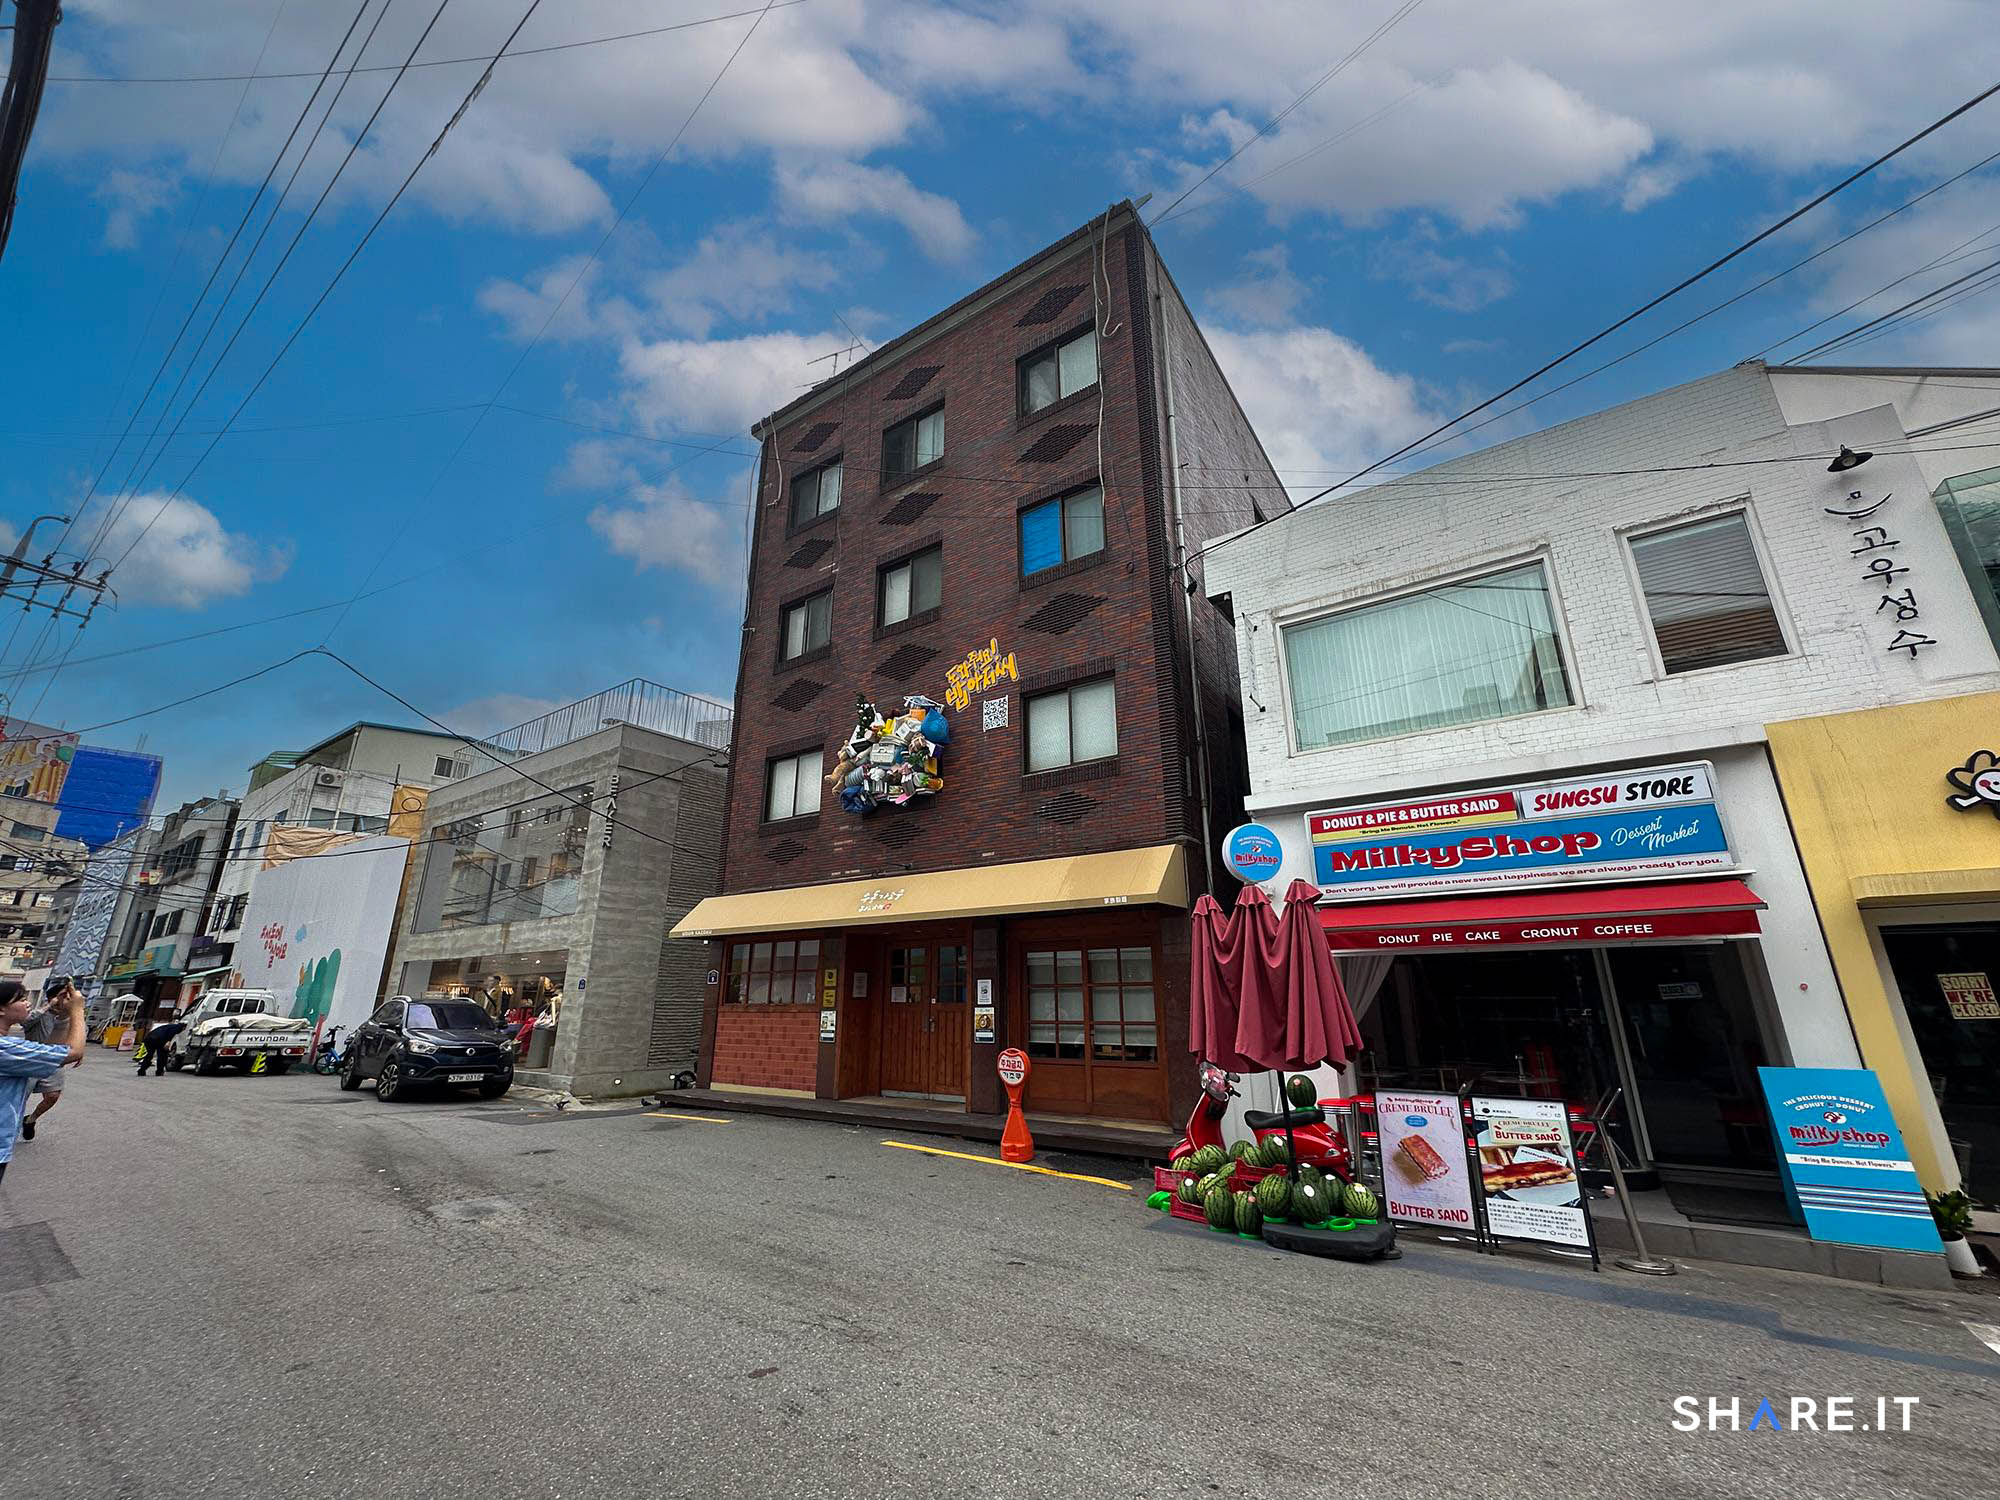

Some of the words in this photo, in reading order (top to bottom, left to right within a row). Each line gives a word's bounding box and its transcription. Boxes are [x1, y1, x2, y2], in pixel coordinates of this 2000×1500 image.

[1533, 784, 1618, 812] SUNGSU
[1625, 775, 1695, 801] STORE
[1322, 815, 1363, 831] DONUT
[1365, 814, 1376, 825] &
[1376, 811, 1397, 824] PIE
[1398, 810, 1409, 821] &
[1410, 803, 1460, 820] BUTTER
[1462, 799, 1500, 814] SAND
[1610, 815, 1663, 846] Dessert
[1641, 819, 1700, 850] Market
[1330, 831, 1602, 872] MilkyShop
[1325, 886, 1348, 894] Don't
[1407, 880, 1444, 889] provide
[1503, 871, 1558, 880] happiness
[1597, 864, 1638, 873] always
[1639, 861, 1675, 869] ready
[1676, 859, 1695, 867] for
[1695, 857, 1723, 866] you.
[1378, 934, 1421, 944] DONUT
[1432, 932, 1453, 942] PIE
[1465, 930, 1501, 941] CAKE
[1520, 926, 1580, 939] CRONUT
[1593, 923, 1654, 936] COFFEE
[1940, 976, 1989, 990] SORRY
[1951, 1003, 2000, 1017] CLOSED
[1001, 1059, 1022, 1069] 주차금지
[1783, 1098, 1797, 1107] THE
[1796, 1094, 1837, 1102] DELICIOUS
[1839, 1096, 1876, 1110] DESSERT
[1835, 1102, 1867, 1114] DONUT
[1495, 1130, 1533, 1141] BUTTER
[1534, 1133, 1562, 1141] SAND
[1390, 1201, 1435, 1219] BUTTER
[1437, 1209, 1469, 1223] SAND
